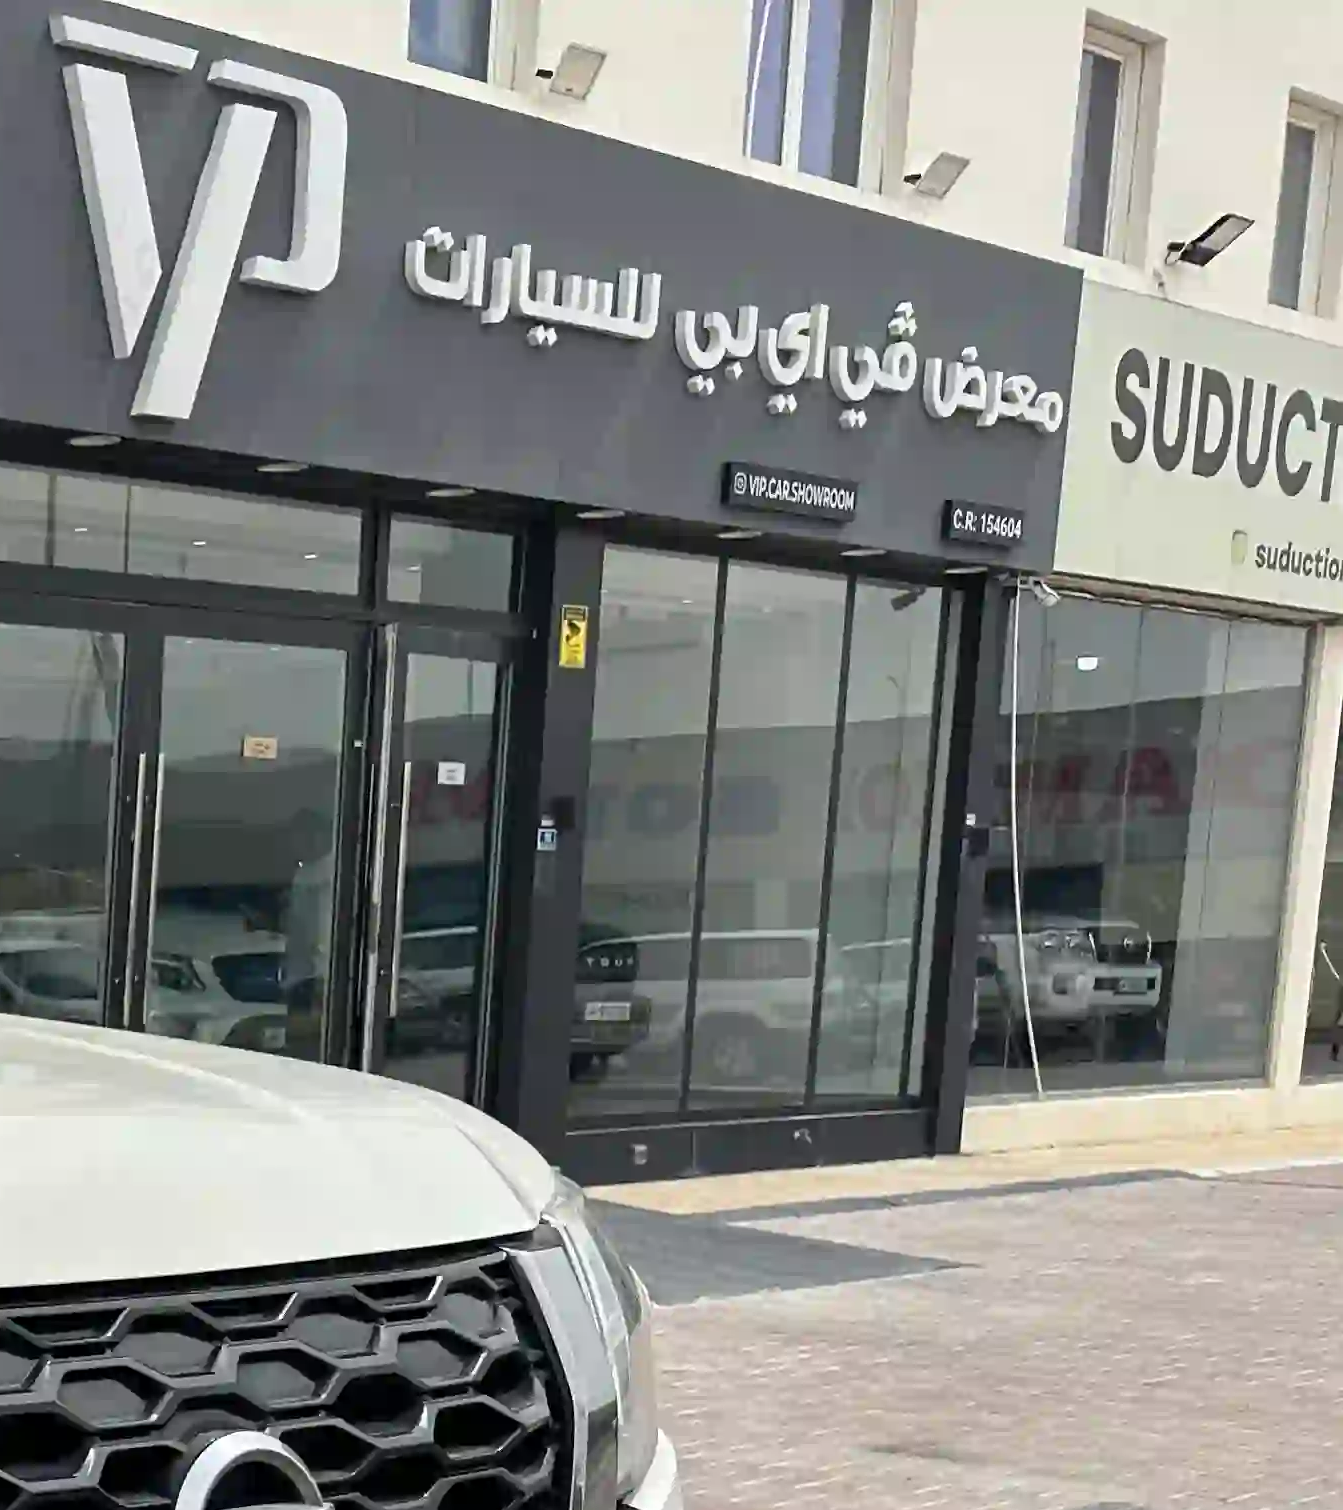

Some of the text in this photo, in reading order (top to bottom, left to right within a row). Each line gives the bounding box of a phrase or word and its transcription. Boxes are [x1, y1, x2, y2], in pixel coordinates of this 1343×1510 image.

[404, 225, 662, 349] للسيارات
[675, 304, 759, 397] بي
[923, 346, 1064, 434] معرض
[980, 514, 1023, 539] 154604
[1255, 541, 1343, 582] suductio
